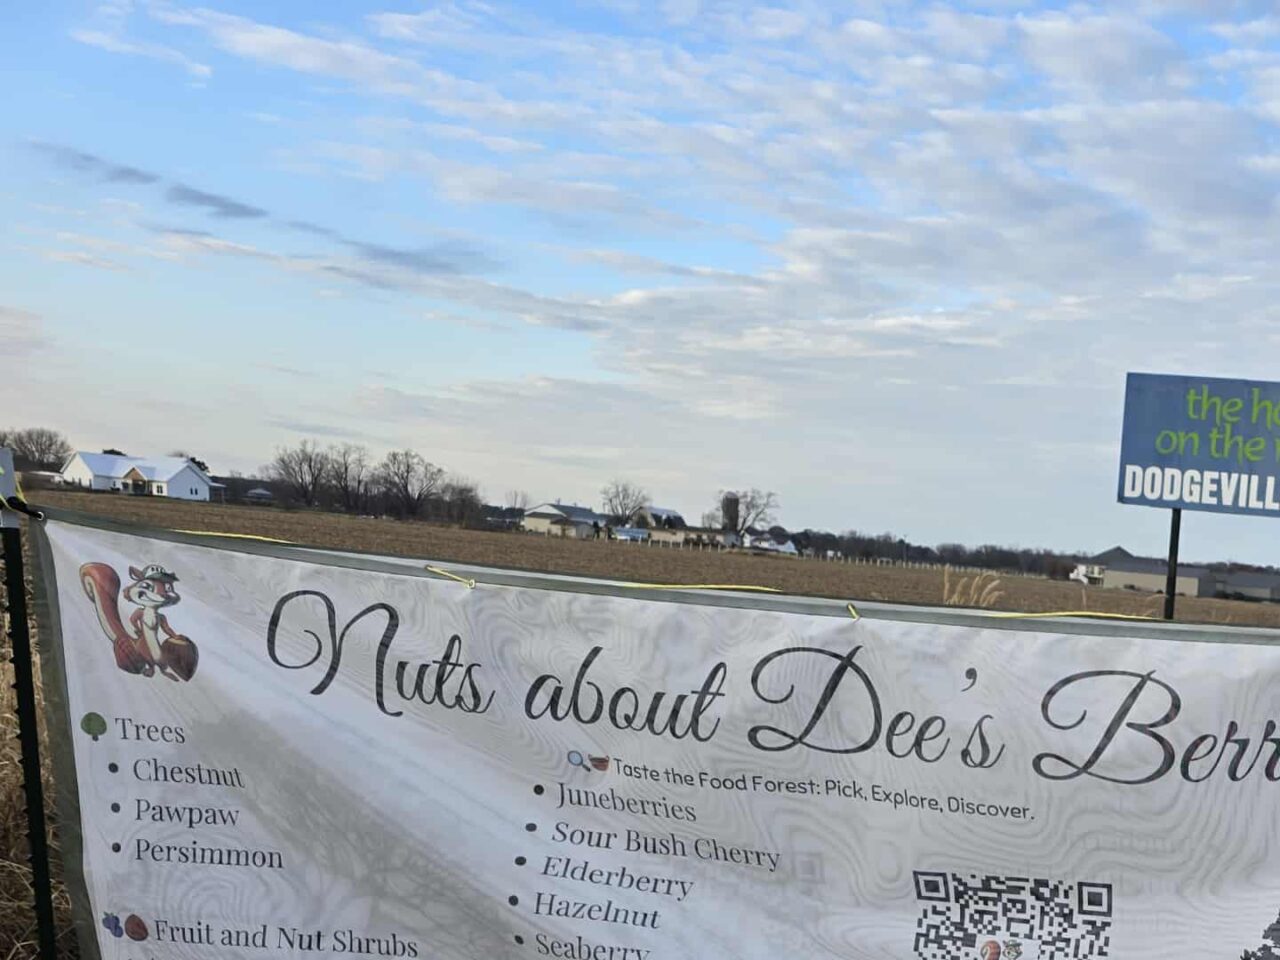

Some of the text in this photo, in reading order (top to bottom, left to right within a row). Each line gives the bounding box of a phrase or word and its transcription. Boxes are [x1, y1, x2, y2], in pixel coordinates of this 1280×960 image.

[1186, 384, 1243, 425] the
[1155, 429, 1200, 456] on
[1209, 423, 1266, 464] the
[267, 590, 496, 717] Nuts
[524, 646, 727, 743] about
[747, 645, 1006, 769] Dee's
[115, 717, 186, 744] Trees
[133, 758, 245, 789] Chestnut
[613, 758, 1035, 820] Taste the Food Forest: Pick, Explore, Discover.
[134, 799, 240, 829] Pawpaw
[556, 782, 697, 822] Juneberries
[134, 838, 284, 870] Persimmon
[551, 821, 781, 873] Sour Bush Cherry
[539, 856, 695, 902] Elderberry
[533, 891, 662, 930] Hazelnut
[154, 919, 419, 958] Fruit and Nut Shrubs
